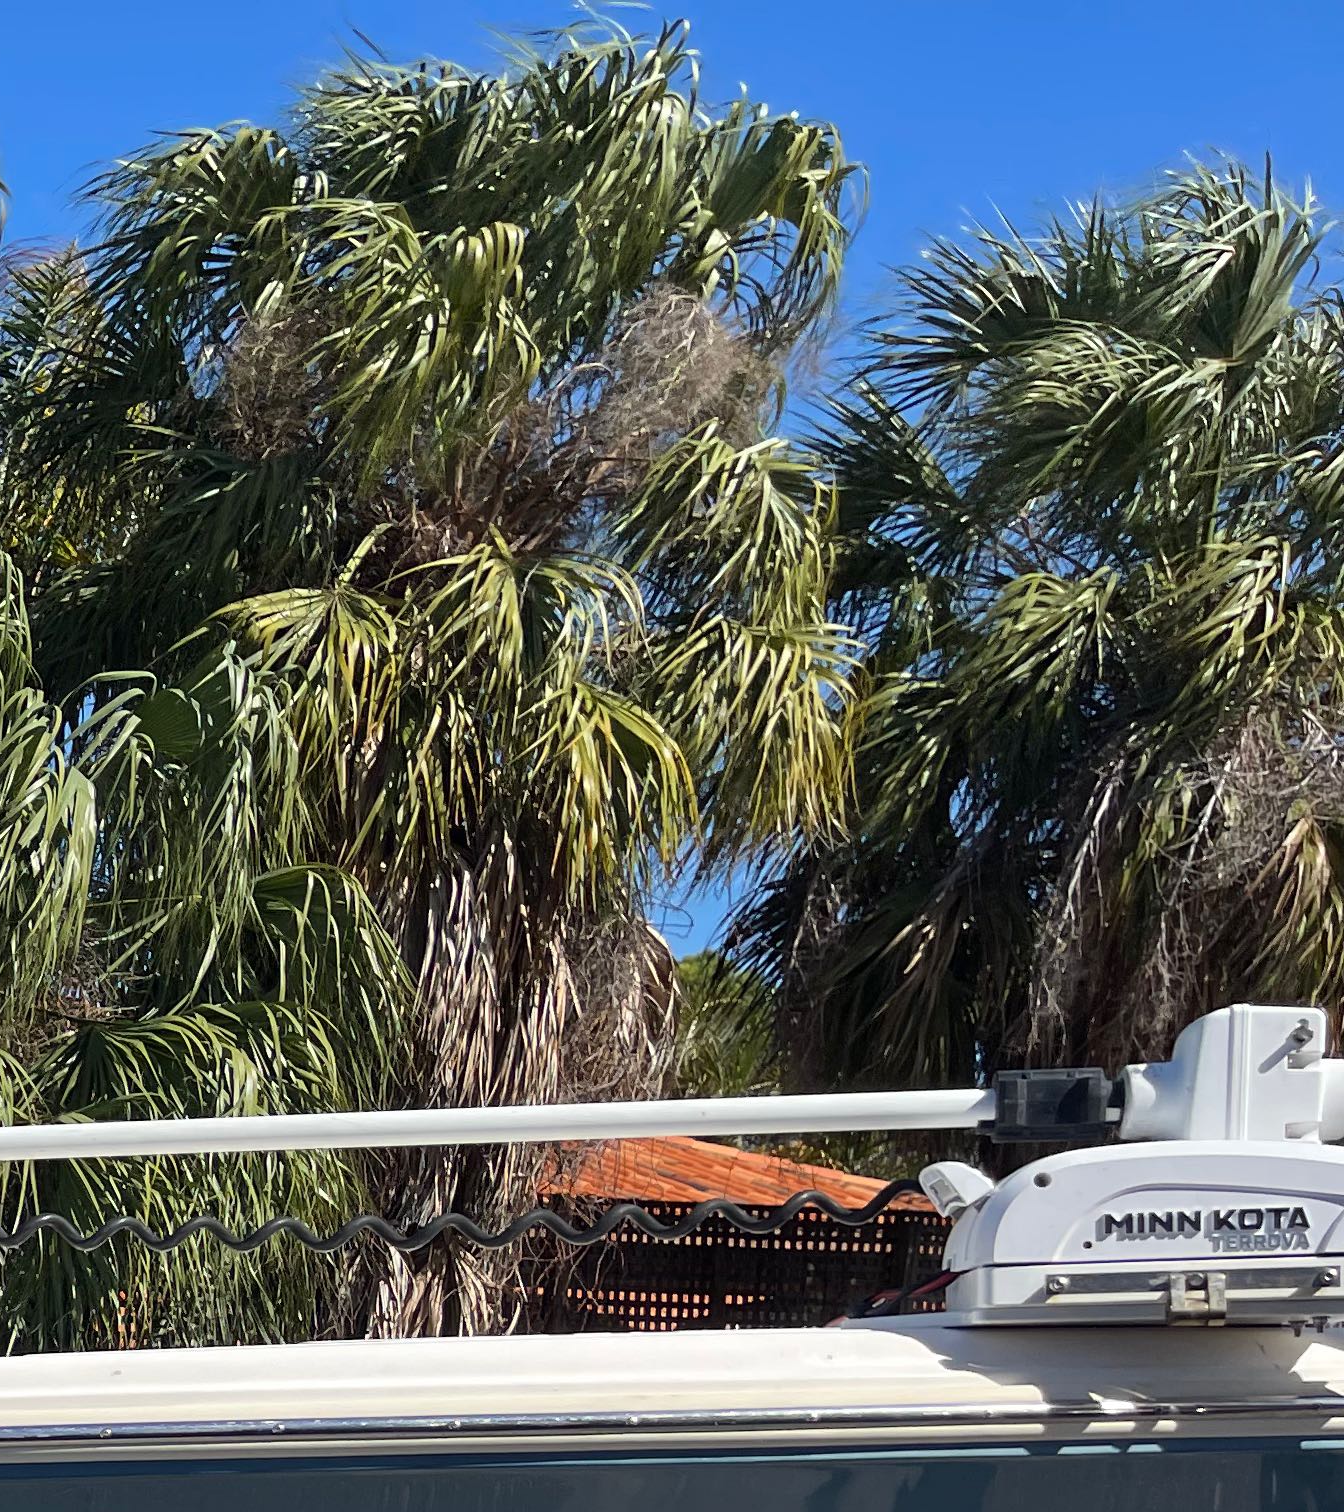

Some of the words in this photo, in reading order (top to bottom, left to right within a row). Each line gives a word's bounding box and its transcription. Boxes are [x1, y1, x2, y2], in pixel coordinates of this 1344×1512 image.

[1102, 1210, 1202, 1235] MINN
[1212, 1206, 1311, 1231] KOTA
[1211, 1232, 1310, 1253] TERROVA
